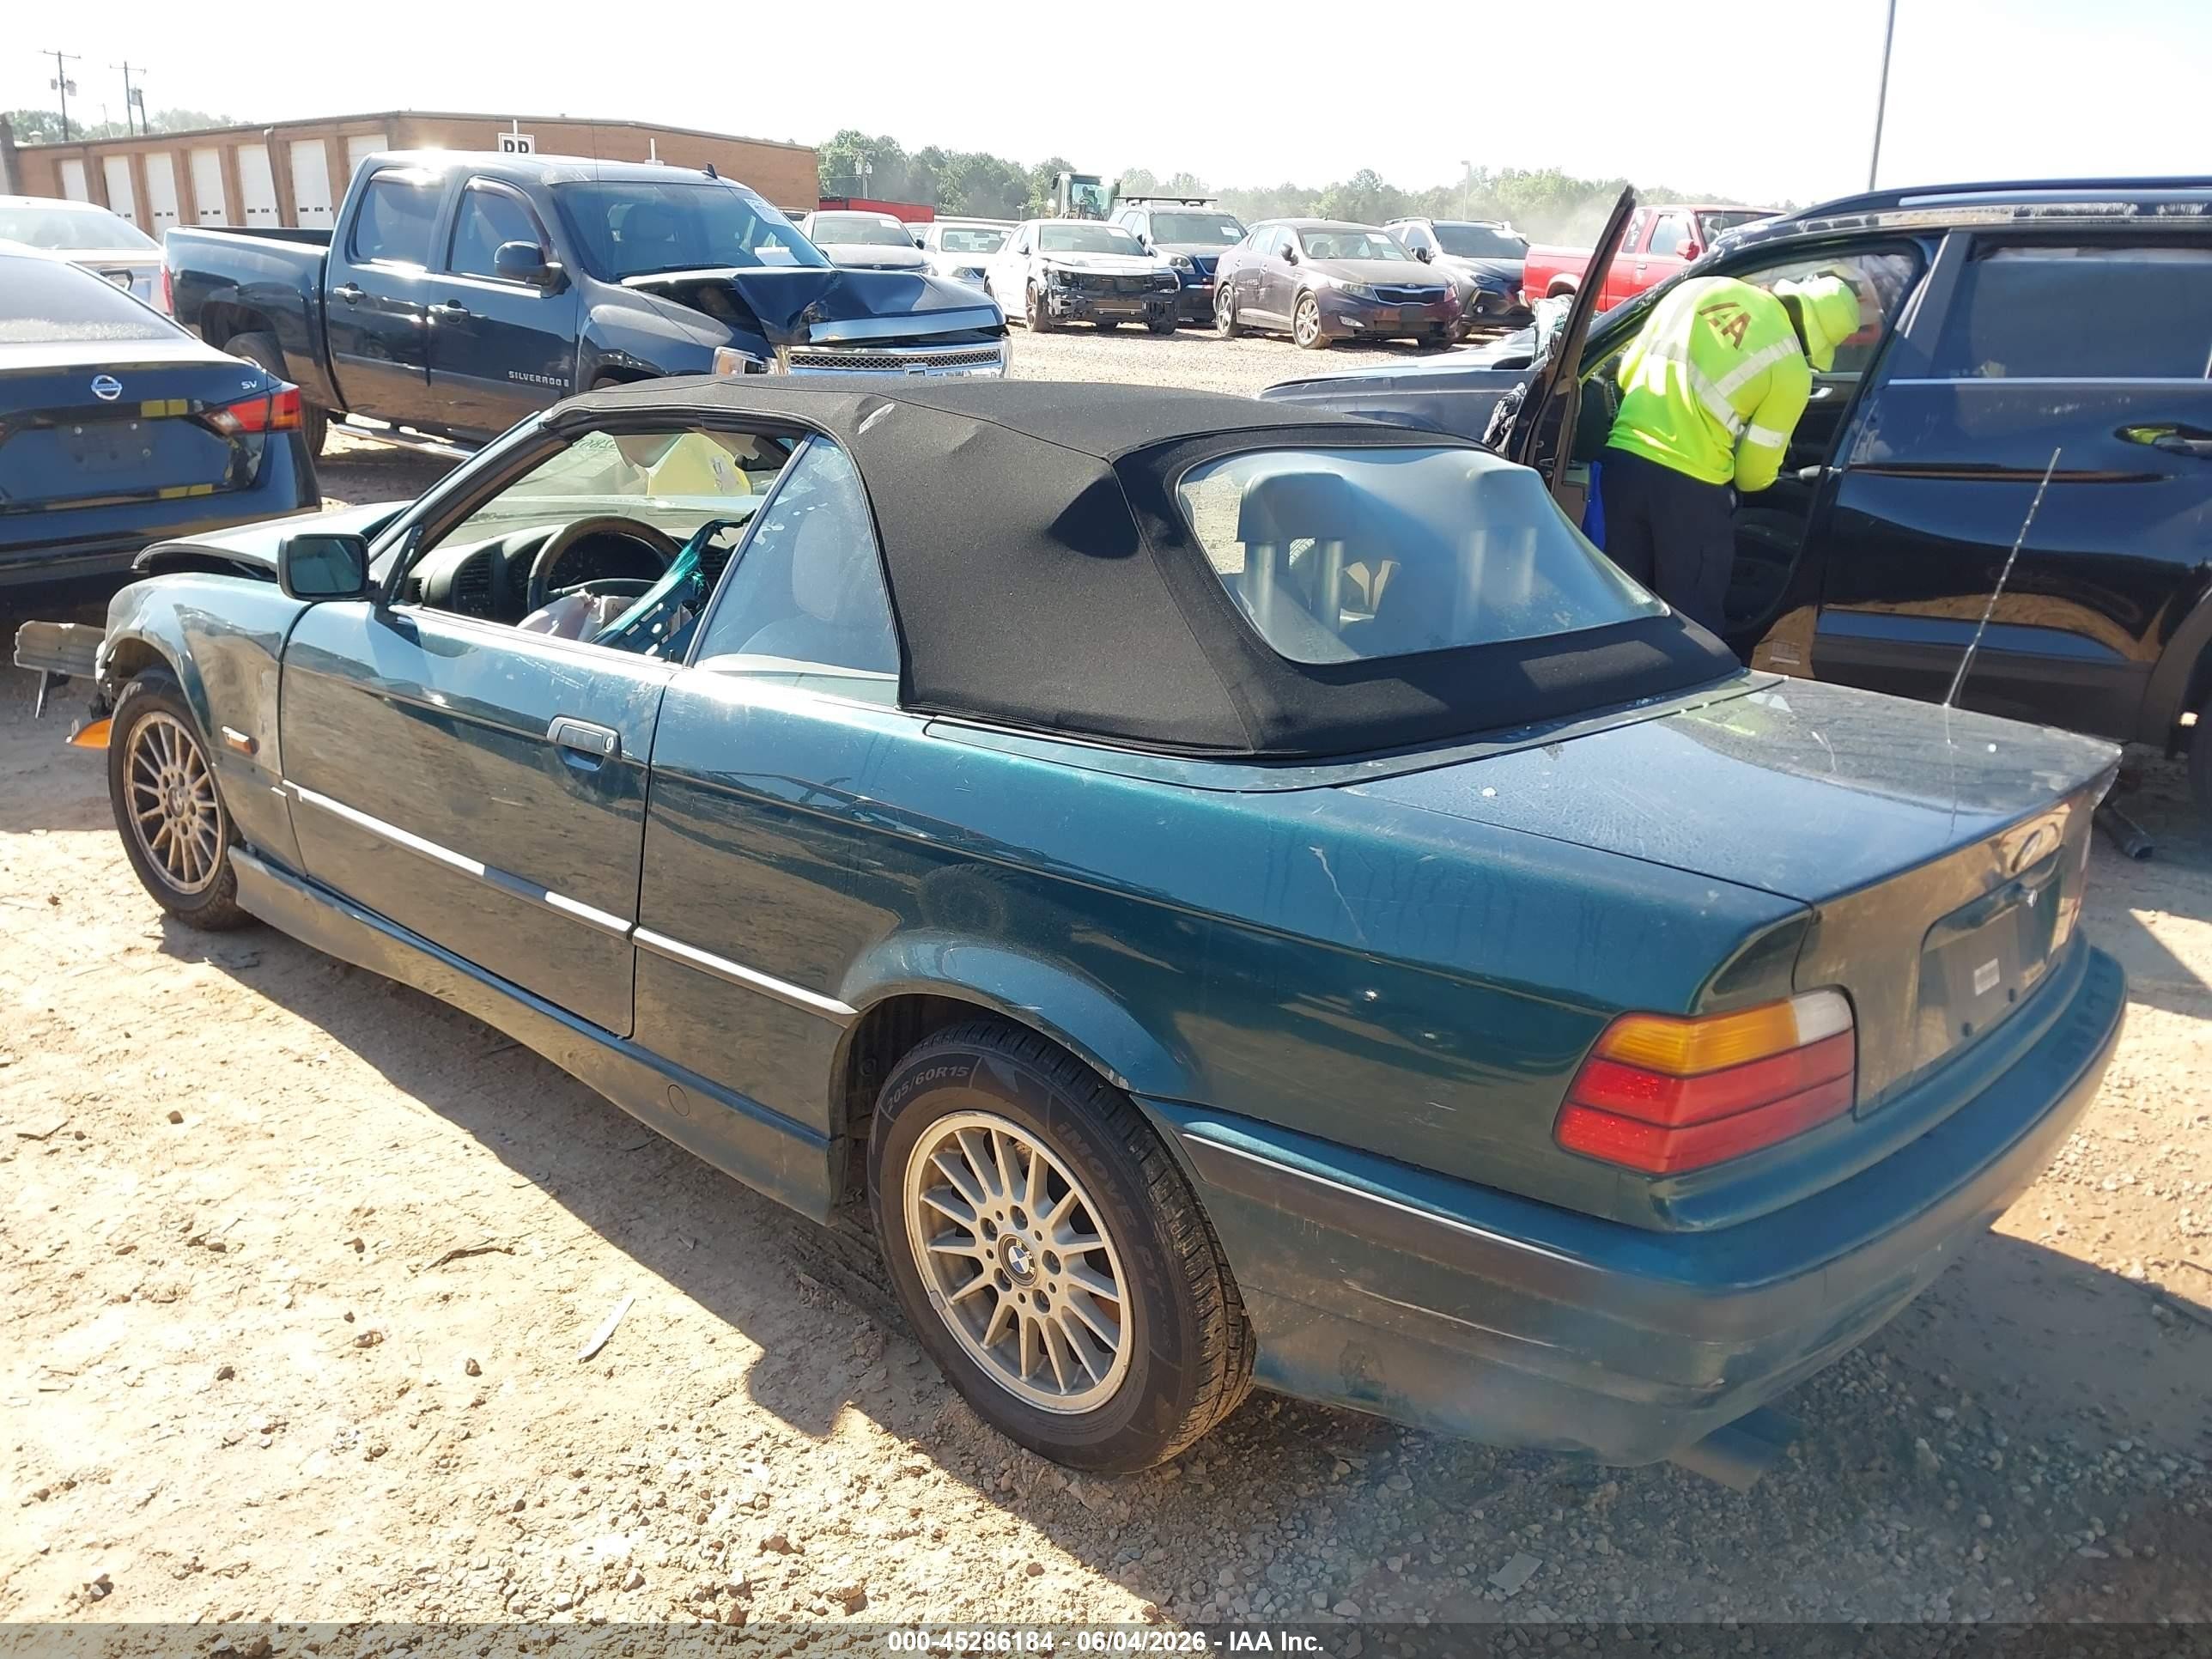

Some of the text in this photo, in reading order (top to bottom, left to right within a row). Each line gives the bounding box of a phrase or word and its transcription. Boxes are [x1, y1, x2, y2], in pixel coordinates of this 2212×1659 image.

[240, 380, 257, 389] SV
[508, 370, 562, 386] SILVERADO
[887, 1066, 969, 1114] 205/60R15
